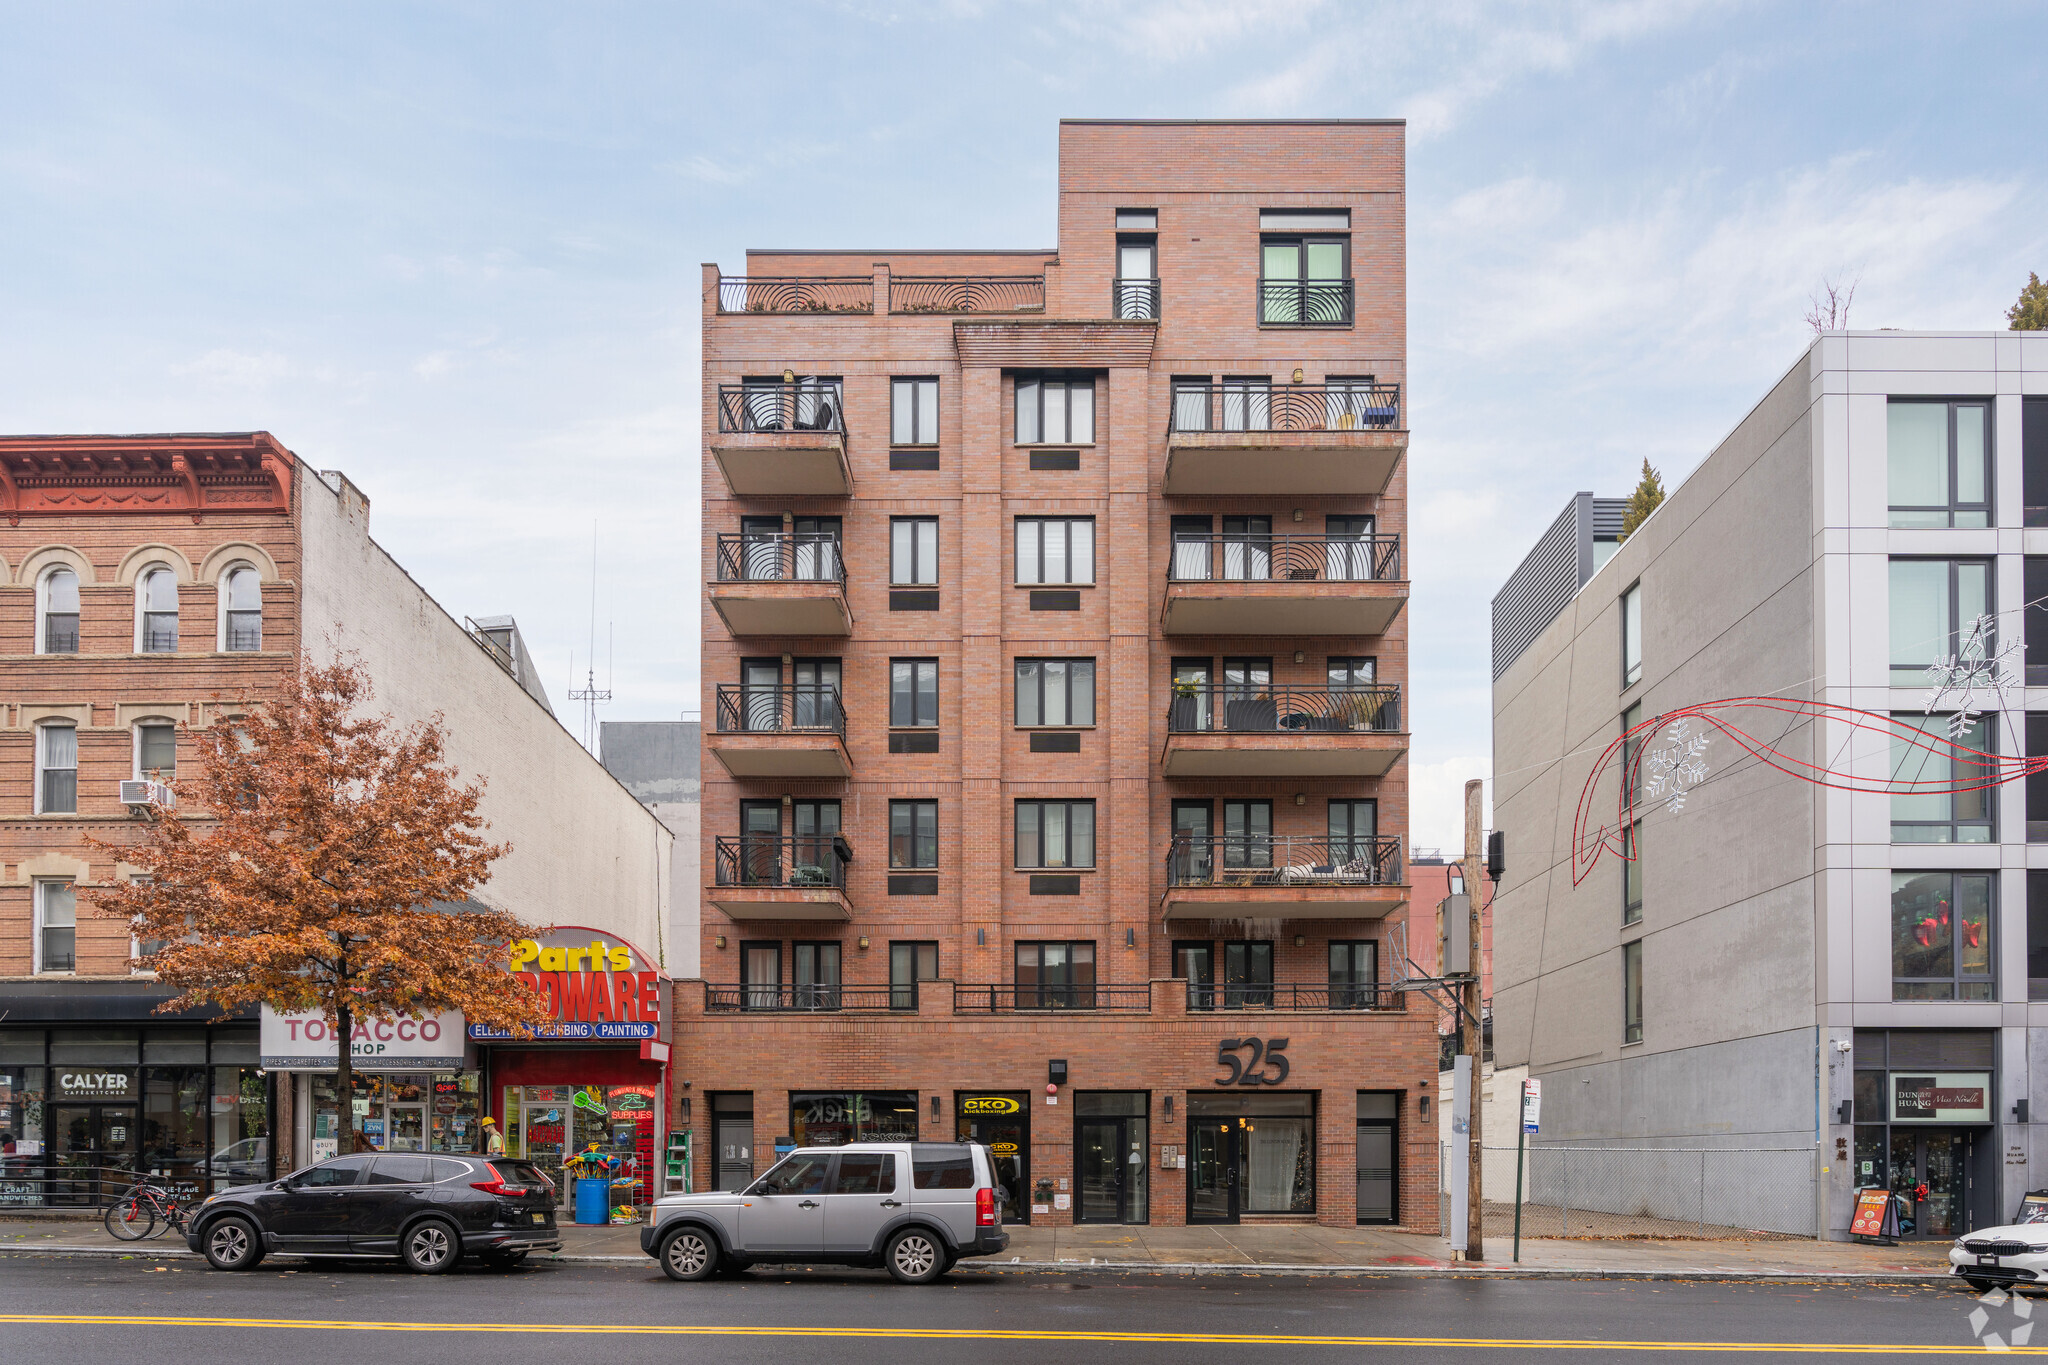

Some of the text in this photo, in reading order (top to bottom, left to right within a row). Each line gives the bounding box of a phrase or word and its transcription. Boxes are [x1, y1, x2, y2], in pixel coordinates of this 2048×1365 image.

[510, 939, 634, 972] Parts
[537, 1024, 588, 1036] PUBING
[601, 1024, 649, 1036] PAINTING
[351, 1043, 386, 1055] HOP
[265, 1058, 282, 1066] PIPES
[287, 1058, 321, 1066] CIGARETTES
[354, 1058, 377, 1066] HOOKAH
[378, 1058, 416, 1066] ACCESSORIES
[422, 1058, 437, 1066] SODA
[443, 1058, 460, 1066] GIFTS
[1215, 1037, 1290, 1085] 525
[61, 1073, 129, 1090] CALYER
[435, 1083, 457, 1093] Open
[1898, 1091, 1918, 1099] DUN
[1933, 1095, 1952, 1103] Miss
[964, 1100, 1006, 1109] CKO
[1898, 1099, 1932, 1107] HUANG
[611, 1110, 653, 1119] SUPPLIES
[527, 1125, 565, 1144] HARDWARE
